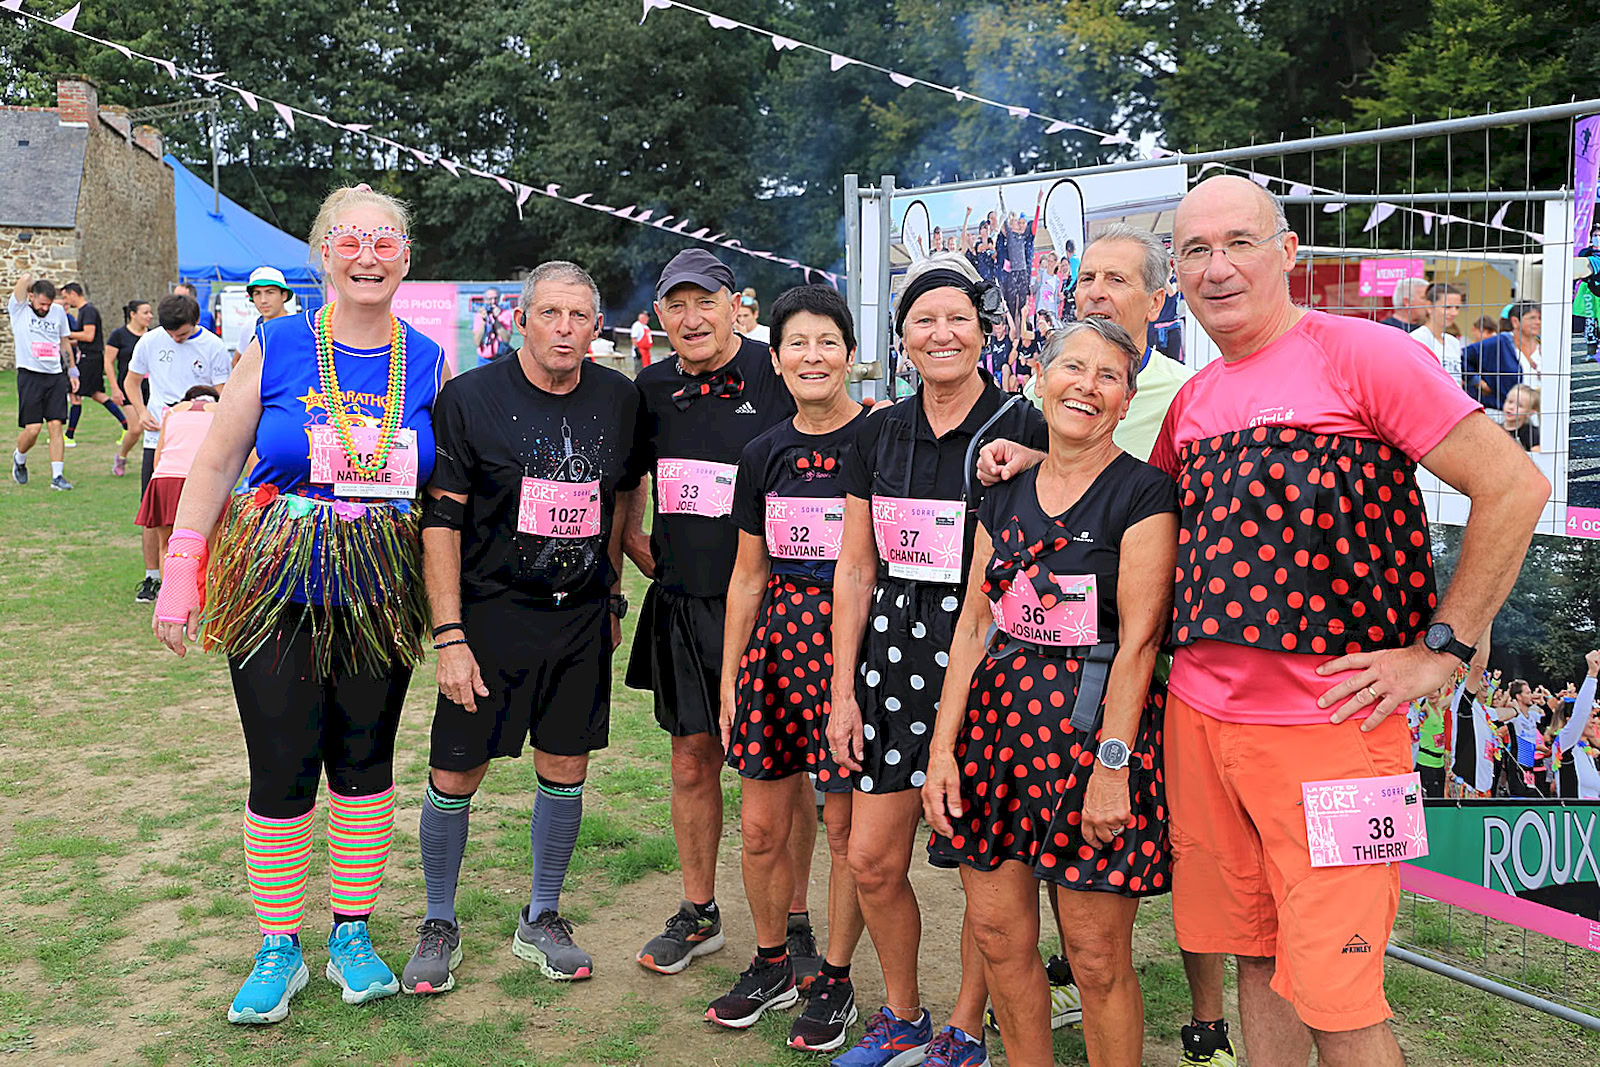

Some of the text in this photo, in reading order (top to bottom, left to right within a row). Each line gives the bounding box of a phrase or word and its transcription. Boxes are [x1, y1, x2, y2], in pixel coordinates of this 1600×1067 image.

[411, 299, 452, 310] PHOTOS
[414, 315, 442, 325] album
[158, 350, 175, 363] 26
[336, 470, 392, 483] NATHALIE
[658, 466, 683, 478] FORT
[523, 485, 558, 500] FORT
[680, 484, 699, 499] 33
[676, 501, 698, 512] JOEL
[873, 504, 936, 520] FORT SORRE
[548, 507, 588, 523] 1027
[1567, 515, 1578, 530] 4
[551, 525, 581, 535] ALAIN
[790, 526, 810, 543] 32
[900, 529, 920, 548] 37
[778, 544, 825, 557] SYLVIANE
[889, 548, 934, 564] CHANTAL
[1021, 604, 1045, 625] 36
[1010, 622, 1062, 642] JOSIANE
[1306, 786, 1404, 811] FORT SORRE
[1368, 816, 1395, 840] 38
[1352, 841, 1408, 861] THIERRY
[1483, 809, 1600, 897] ROUX
